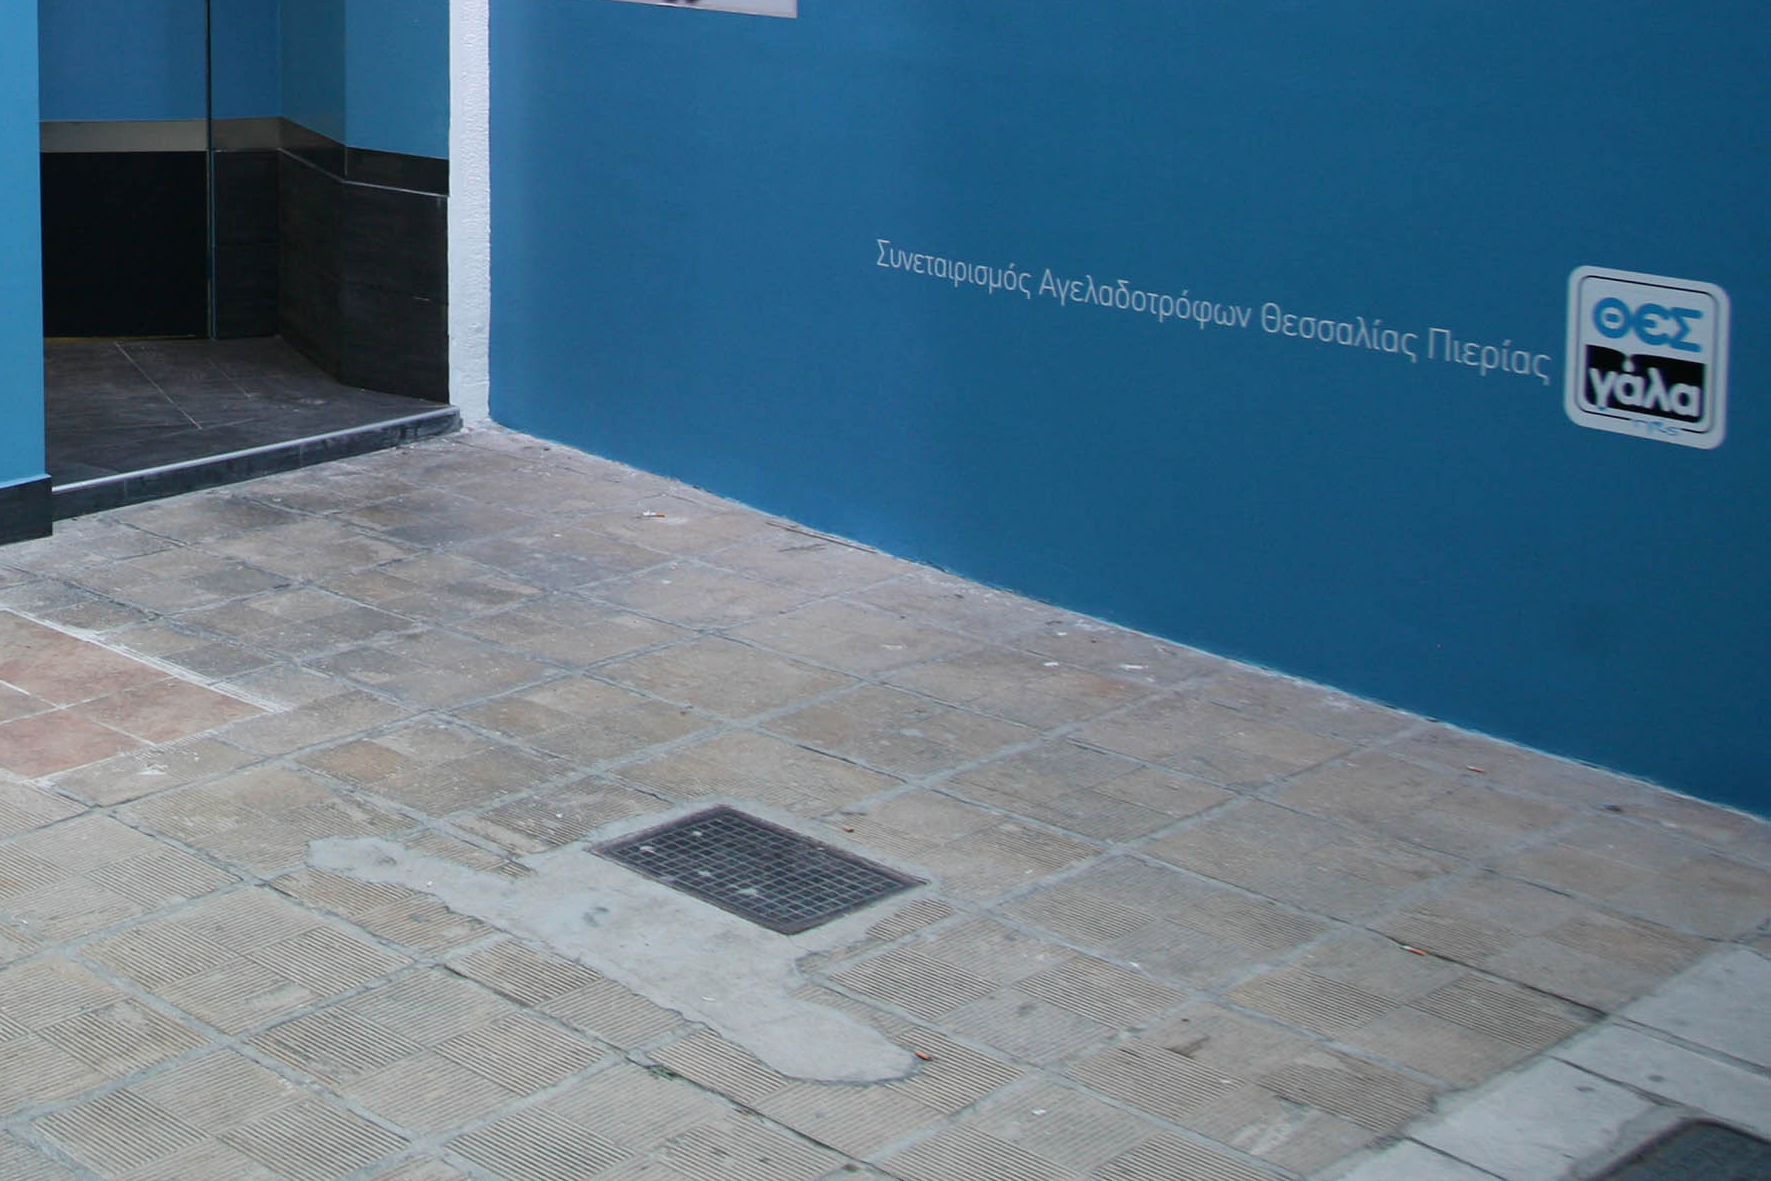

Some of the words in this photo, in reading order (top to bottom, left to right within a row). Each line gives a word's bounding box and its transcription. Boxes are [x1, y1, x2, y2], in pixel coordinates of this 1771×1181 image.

[876, 238, 1032, 299] Συνεταιρισμός
[1039, 268, 1252, 330] Αγελαδοτρόφων
[1261, 302, 1418, 359] Θεσσαλίας
[1429, 327, 1552, 385] Πιερίας
[1588, 360, 1702, 418] γάλα
